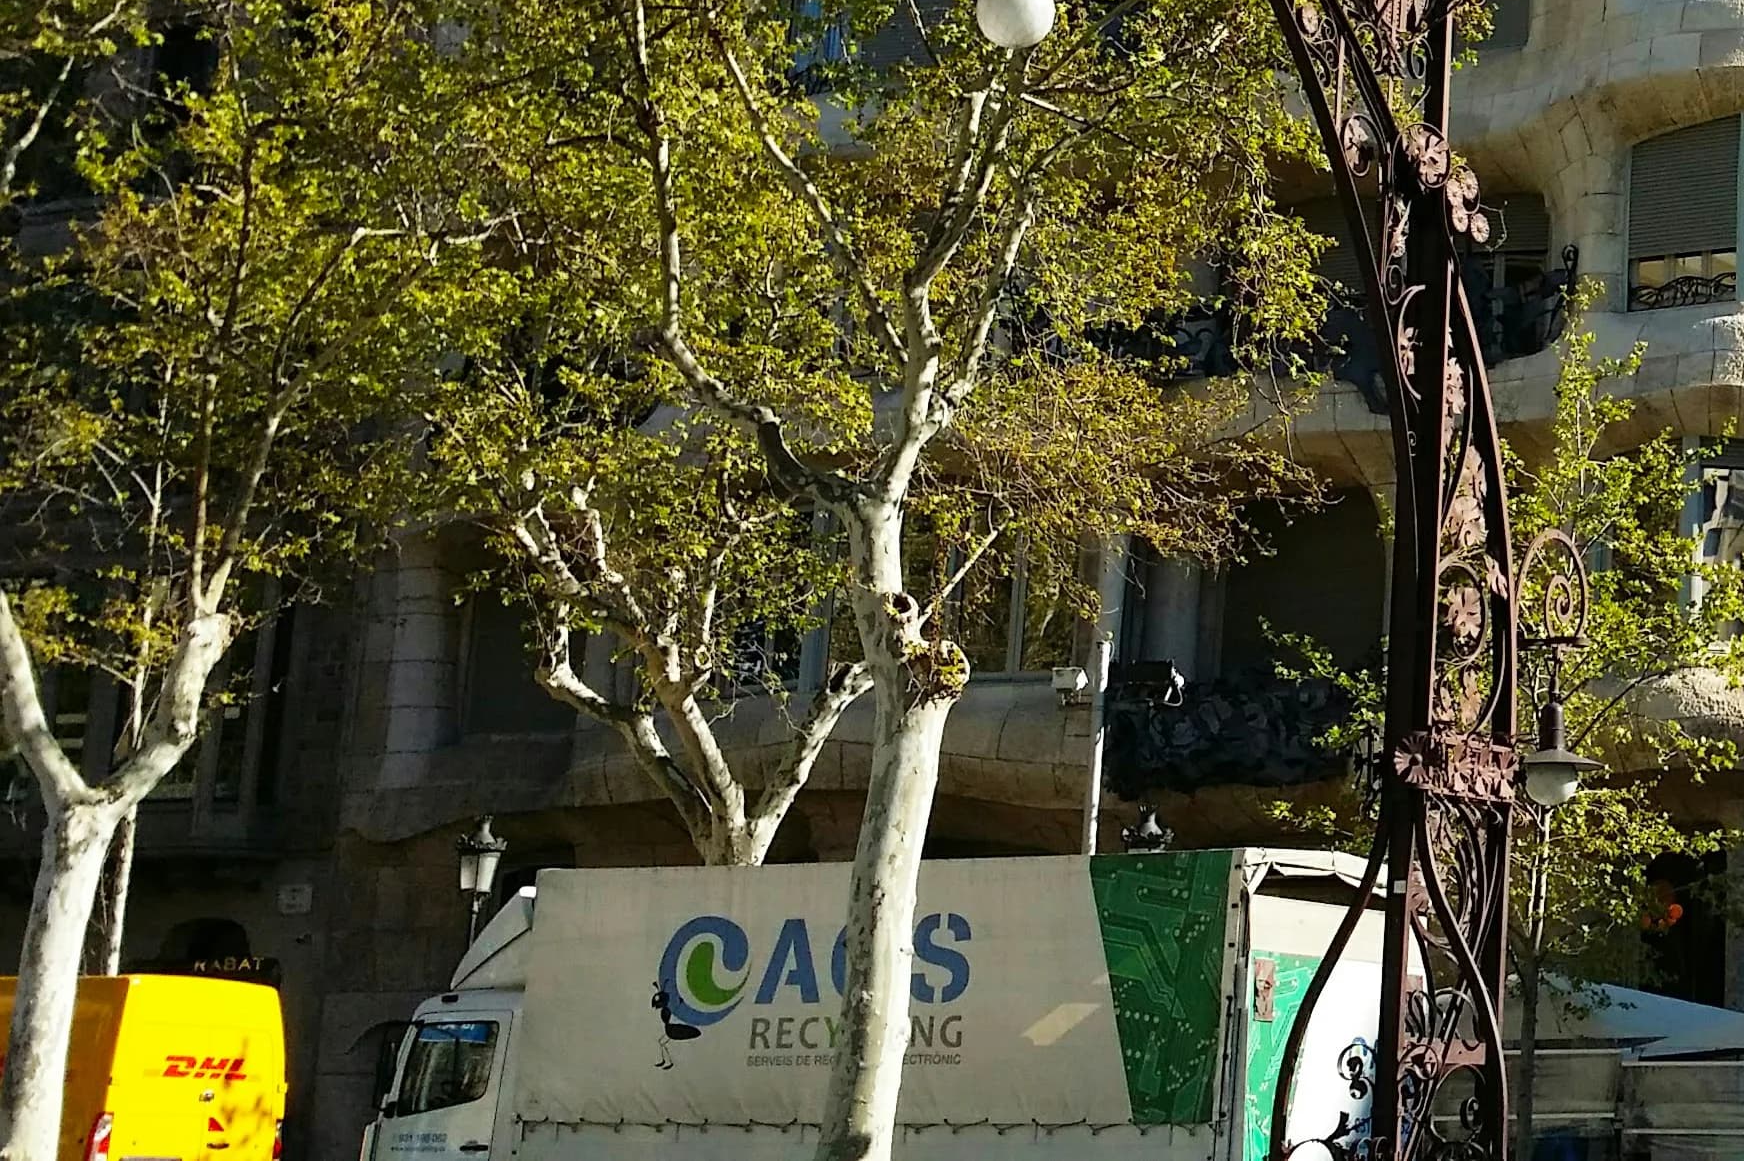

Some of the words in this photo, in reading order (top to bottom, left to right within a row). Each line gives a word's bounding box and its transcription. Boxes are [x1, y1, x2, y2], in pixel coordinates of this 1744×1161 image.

[658, 912, 972, 1027] CAS
[749, 1015, 962, 1051] RECYNG
[162, 1054, 248, 1081] DHL
[746, 1054, 793, 1066] SERVEIS
[796, 1054, 812, 1065] DE
[902, 1050, 961, 1065] ECTRÒNIC
